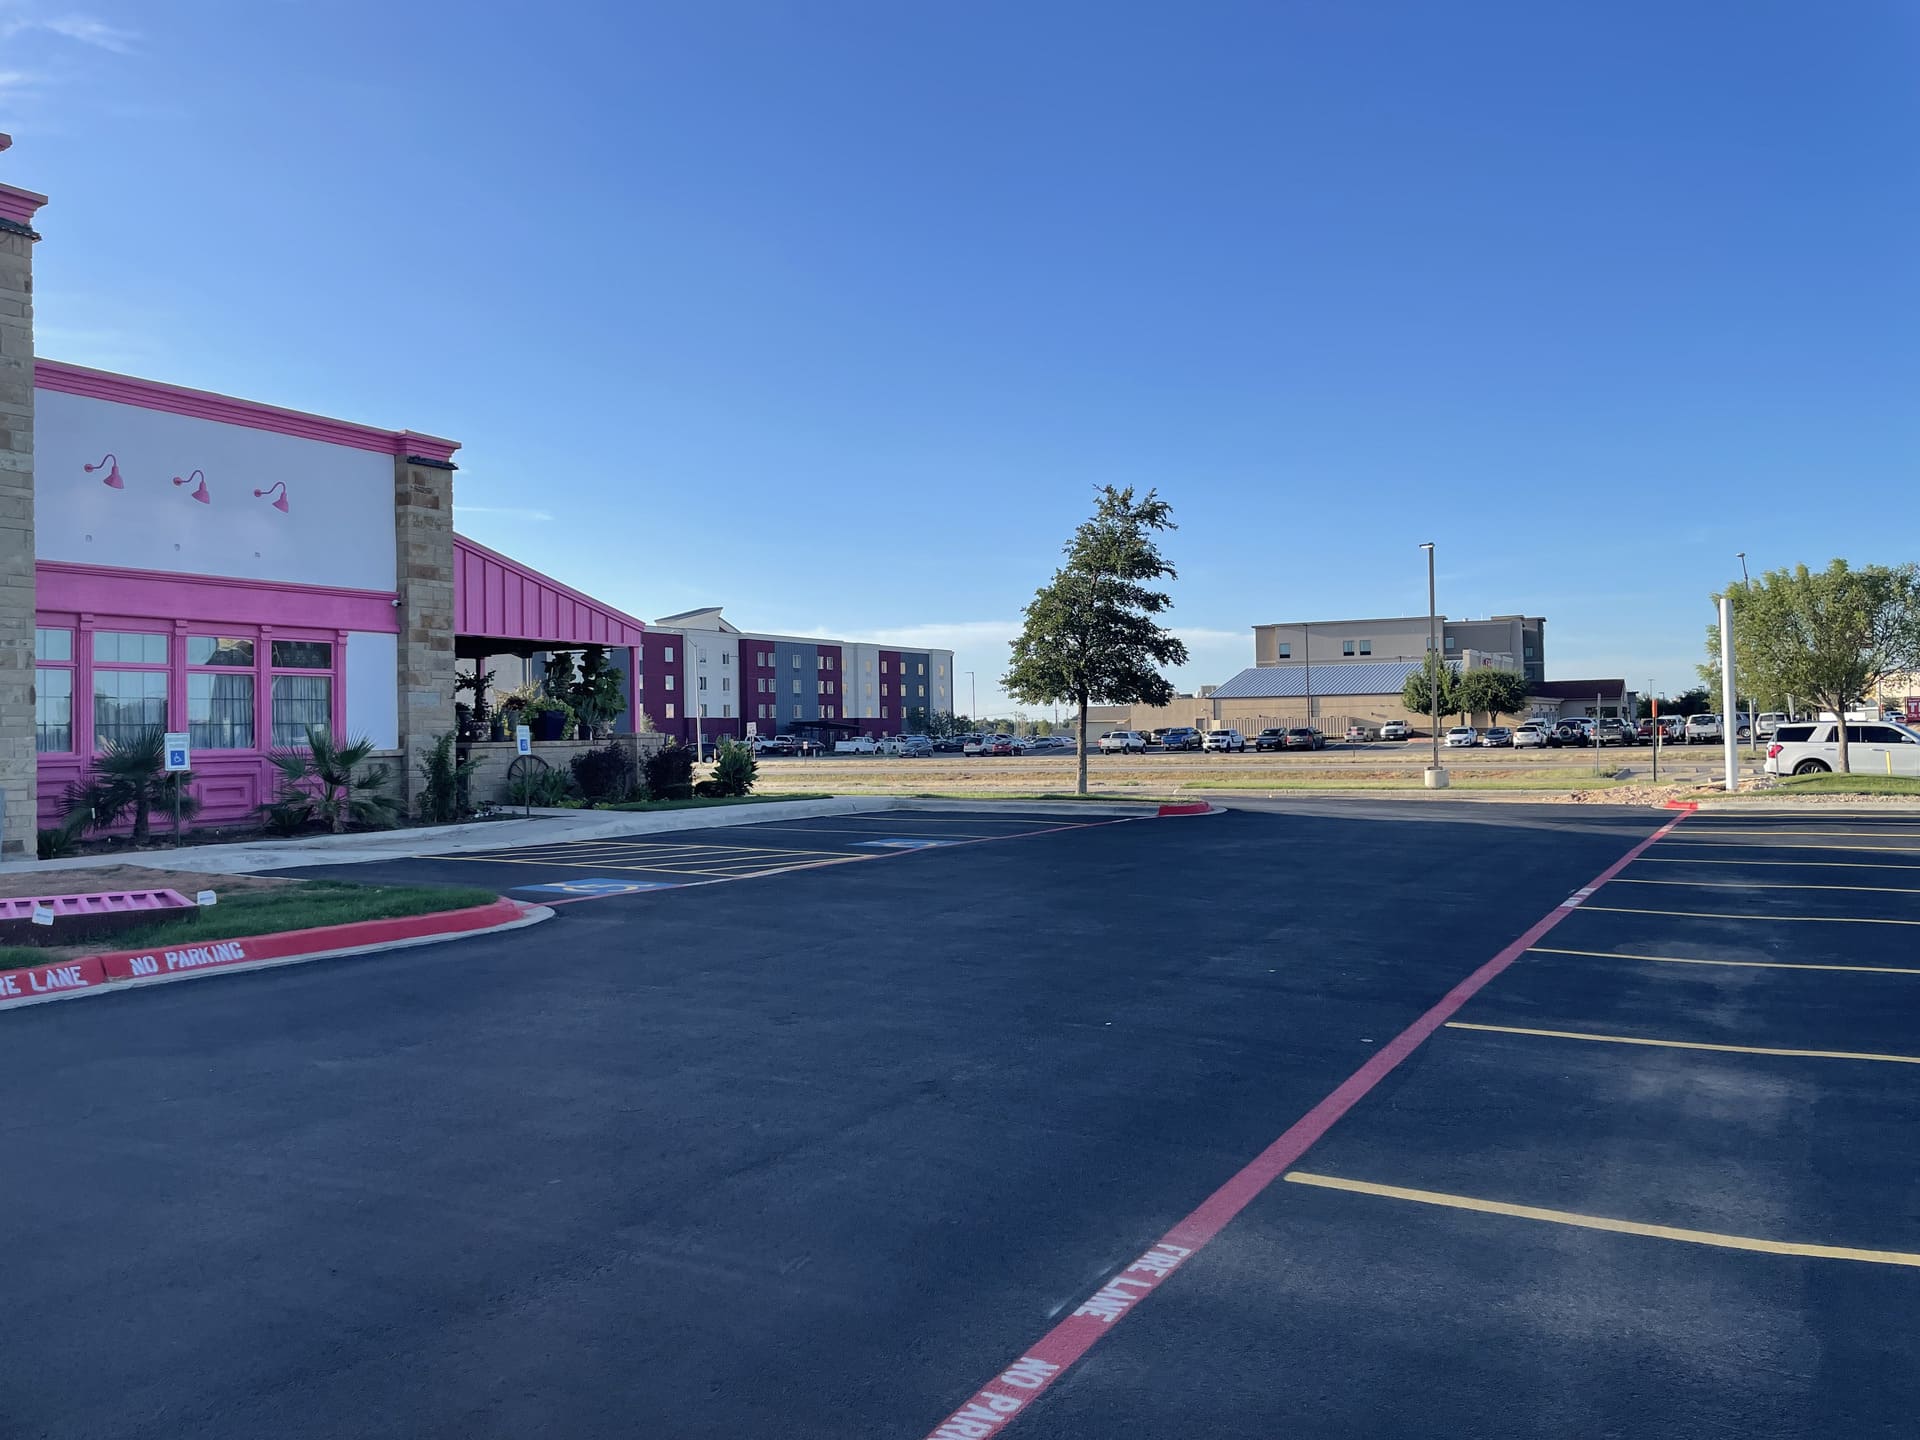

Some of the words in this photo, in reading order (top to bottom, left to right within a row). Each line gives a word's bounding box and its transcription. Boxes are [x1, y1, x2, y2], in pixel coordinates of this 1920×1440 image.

[28, 965, 89, 992] LANE
[129, 956, 159, 976] NO
[164, 941, 245, 970] PARKING
[1127, 1243, 1192, 1278] FIRE
[1072, 1276, 1153, 1323] LANE
[1001, 1356, 1060, 1389] NO
